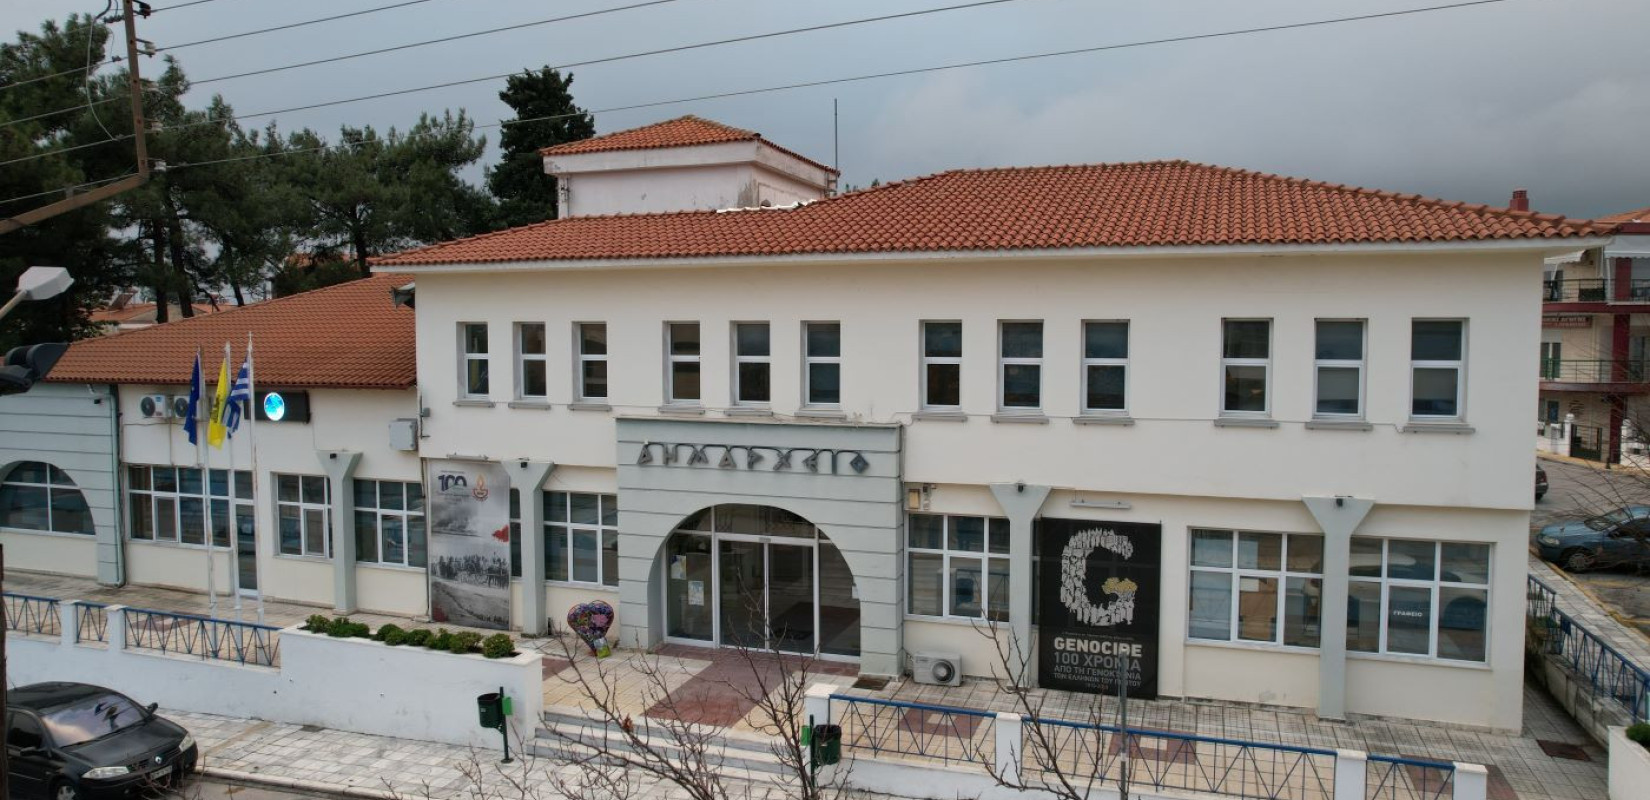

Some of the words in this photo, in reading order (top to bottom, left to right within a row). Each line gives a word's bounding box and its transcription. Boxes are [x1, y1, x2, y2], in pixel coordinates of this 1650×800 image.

[637, 441, 870, 475] ΔΗΜΑΡΧΕΙΟ
[438, 474, 467, 491] 100
[1054, 637, 1142, 657] GENOCIDE
[1054, 651, 1080, 665] 100
[1054, 665, 1072, 673] ΑΠΟ
[1087, 667, 1141, 680] ΓΕΝΟΚΝΙΑ
[1114, 678, 1141, 687] ΠΤΟΥ
